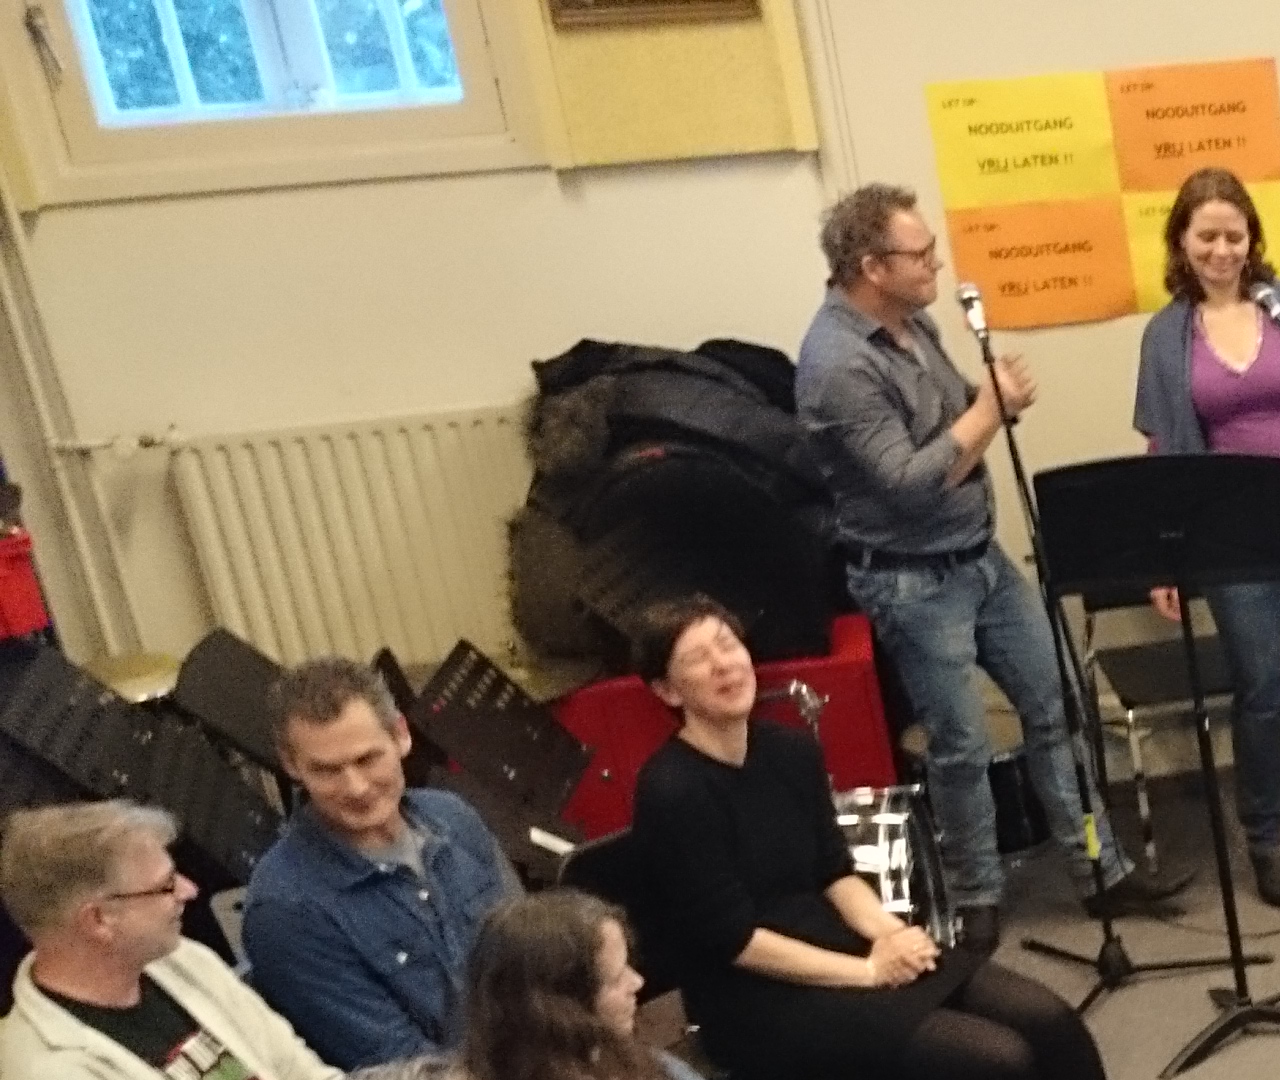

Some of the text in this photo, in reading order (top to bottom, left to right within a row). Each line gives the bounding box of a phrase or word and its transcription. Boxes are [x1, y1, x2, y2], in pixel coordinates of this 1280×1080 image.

[1145, 100, 1246, 120] NOODUITGANG
[968, 116, 1073, 136] NOODUITGANG
[1153, 141, 1184, 157] VRIJ
[1188, 138, 1231, 153] LATEN
[977, 156, 1008, 173] VRIJ
[1013, 153, 1059, 169] LATEN
[988, 240, 1093, 260] NOODUITGANG
[998, 279, 1028, 295] VRIJ
[1033, 274, 1078, 292] LATEN
